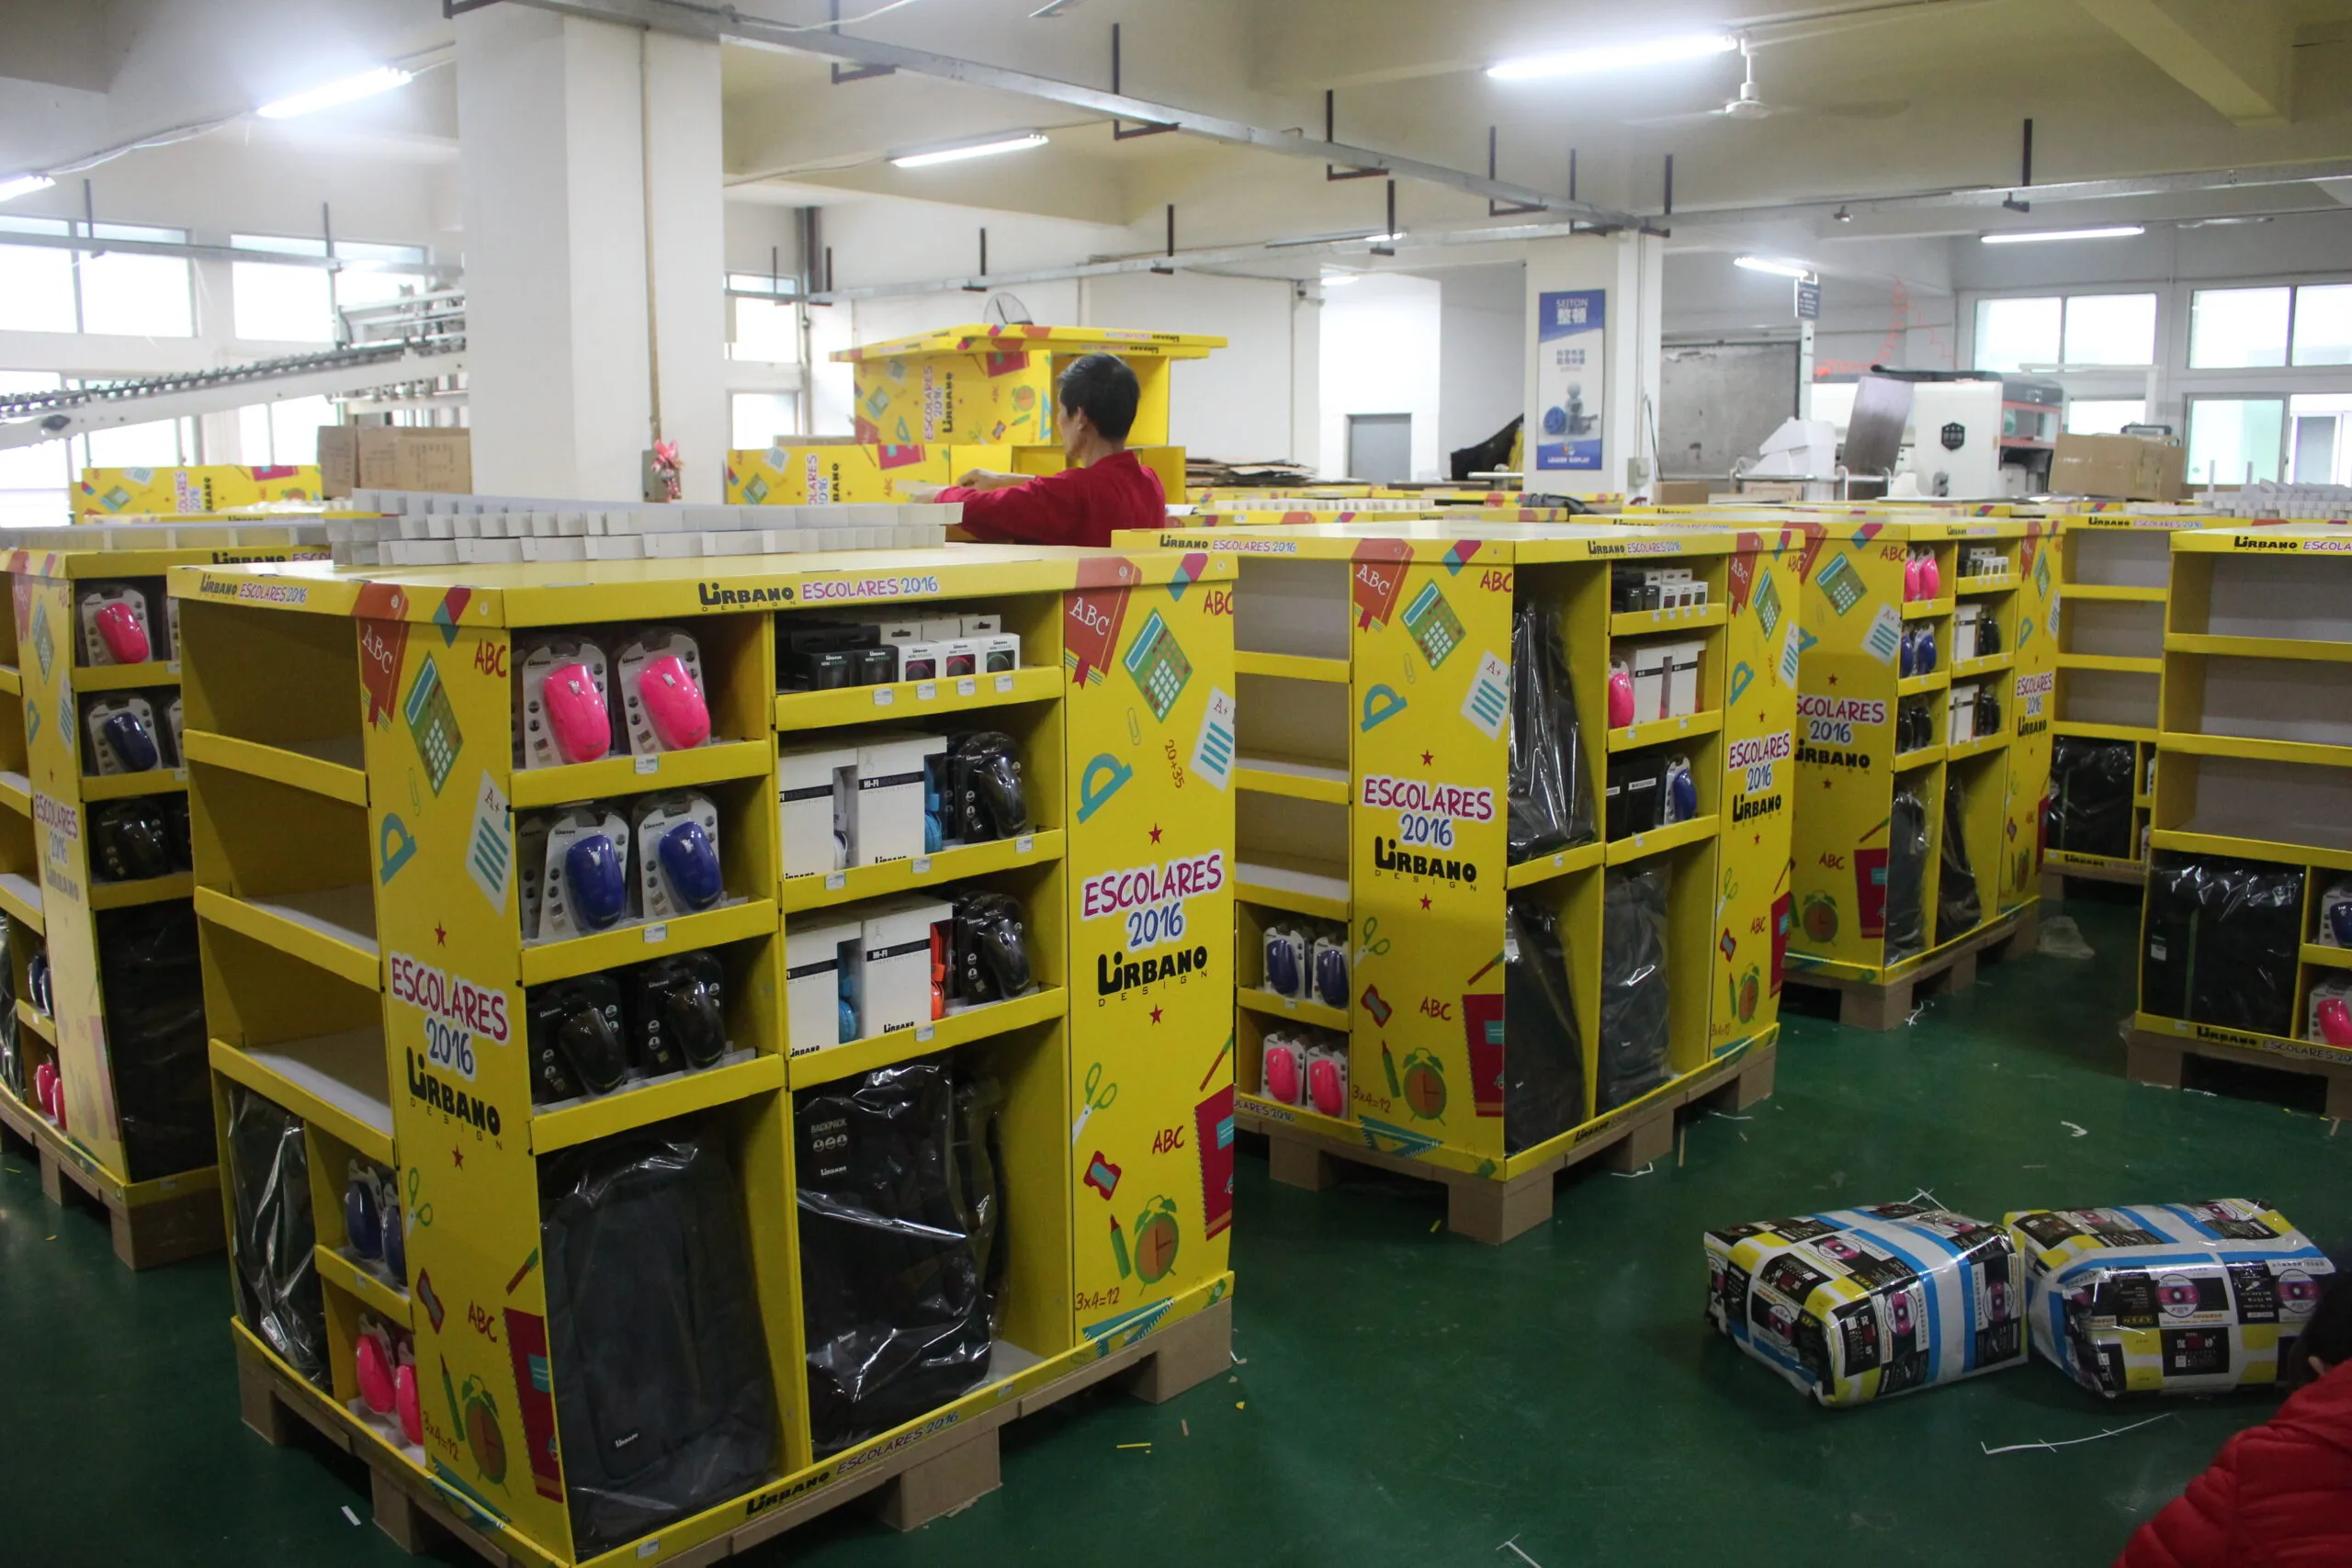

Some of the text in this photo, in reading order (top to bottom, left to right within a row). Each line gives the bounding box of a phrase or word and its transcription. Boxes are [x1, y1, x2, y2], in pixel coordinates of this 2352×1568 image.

[807, 455, 818, 504] OLARES
[820, 478, 828, 504] 016
[1212, 539, 1271, 553] ESCOLARES
[1272, 540, 1296, 553] 2016
[1880, 547, 1905, 562] ABC
[2302, 540, 2352, 552] ESCOLA
[1355, 564, 1391, 597] ABC
[1479, 569, 1512, 593] ABC
[1731, 558, 1749, 584] ABC
[240, 583, 285, 603] ESCOLARES
[285, 586, 308, 604] 2016
[801, 578, 899, 601] ESCOLARES
[899, 575, 940, 594] 2016
[1204, 589, 1234, 616] ABC
[1069, 596, 1111, 637] ABC
[362, 625, 394, 675] ABC
[474, 637, 507, 678] ABC
[1485, 660, 1502, 677] A+
[2017, 672, 2052, 697] ESCOLARES
[1213, 697, 1228, 716] A+
[1796, 695, 1884, 724] SCOLARES
[2027, 695, 2042, 715] 2016
[1810, 720, 1852, 743] 2016
[1164, 739, 1185, 789] 20+35
[1728, 733, 1790, 769] ESCOLARES
[1747, 763, 1771, 792] 2016
[484, 787, 501, 813] A+
[1364, 778, 1493, 820] ESCOLARES
[1401, 814, 1453, 846] 2016
[1818, 852, 1845, 870] ABC
[1084, 853, 1222, 918] ESCOLARES
[1128, 902, 1183, 947] 2016
[1750, 916, 1767, 934] ABC
[390, 957, 508, 1042] ESCOLARES
[1098, 969, 1208, 1008] DESIGN
[1419, 996, 1452, 1021] ABC
[426, 1017, 474, 1075] 2016
[2263, 1040, 2334, 1060] ESCOLARES
[1152, 1125, 1185, 1155] ABC
[1075, 1286, 1120, 1312] 3x4=12
[468, 1300, 497, 1343] ABC
[836, 1428, 924, 1475] ESCOLARES
[924, 1411, 959, 1436] 2016
